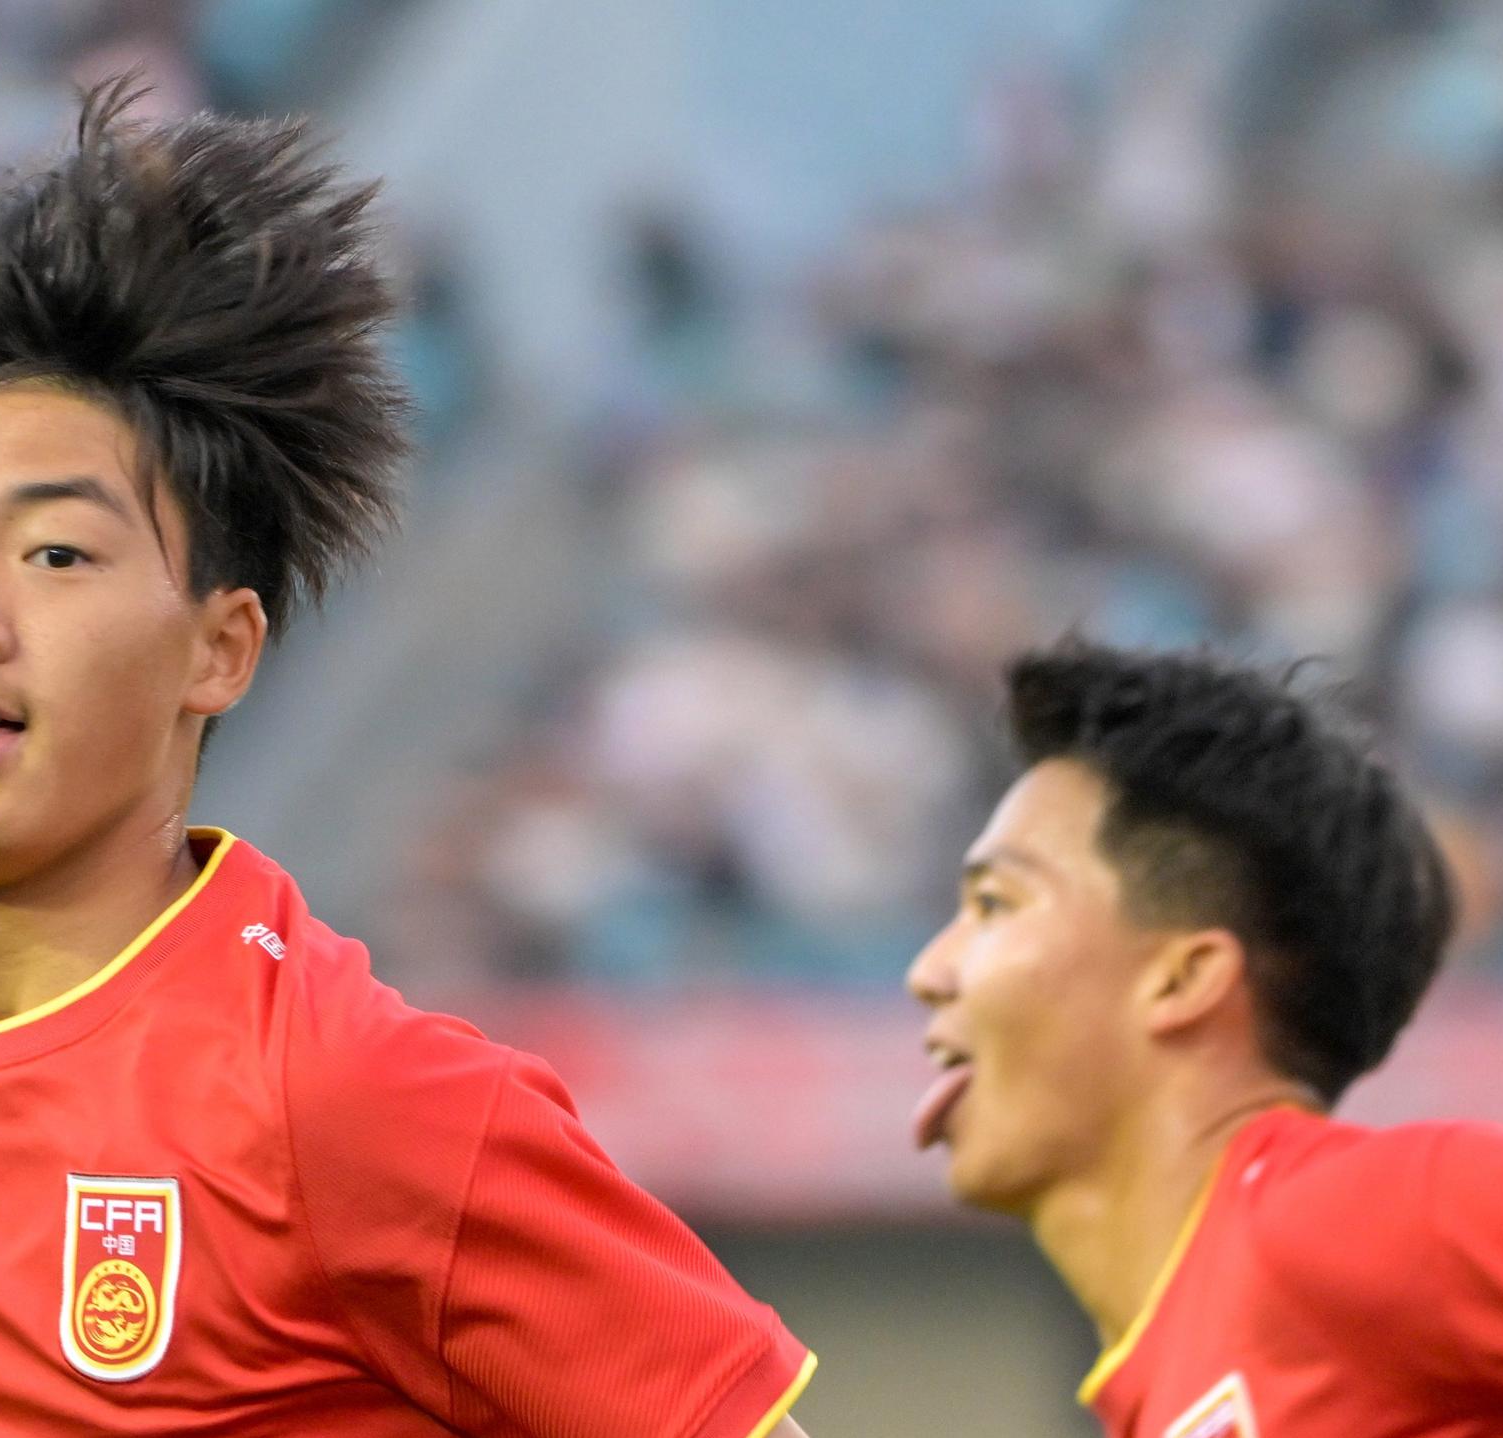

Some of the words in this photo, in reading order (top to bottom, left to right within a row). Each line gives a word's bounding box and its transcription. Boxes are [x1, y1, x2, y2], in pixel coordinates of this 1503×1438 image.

[241, 922, 287, 960] 中国
[81, 1198, 163, 1233] CFA
[102, 1233, 135, 1256] 中国
